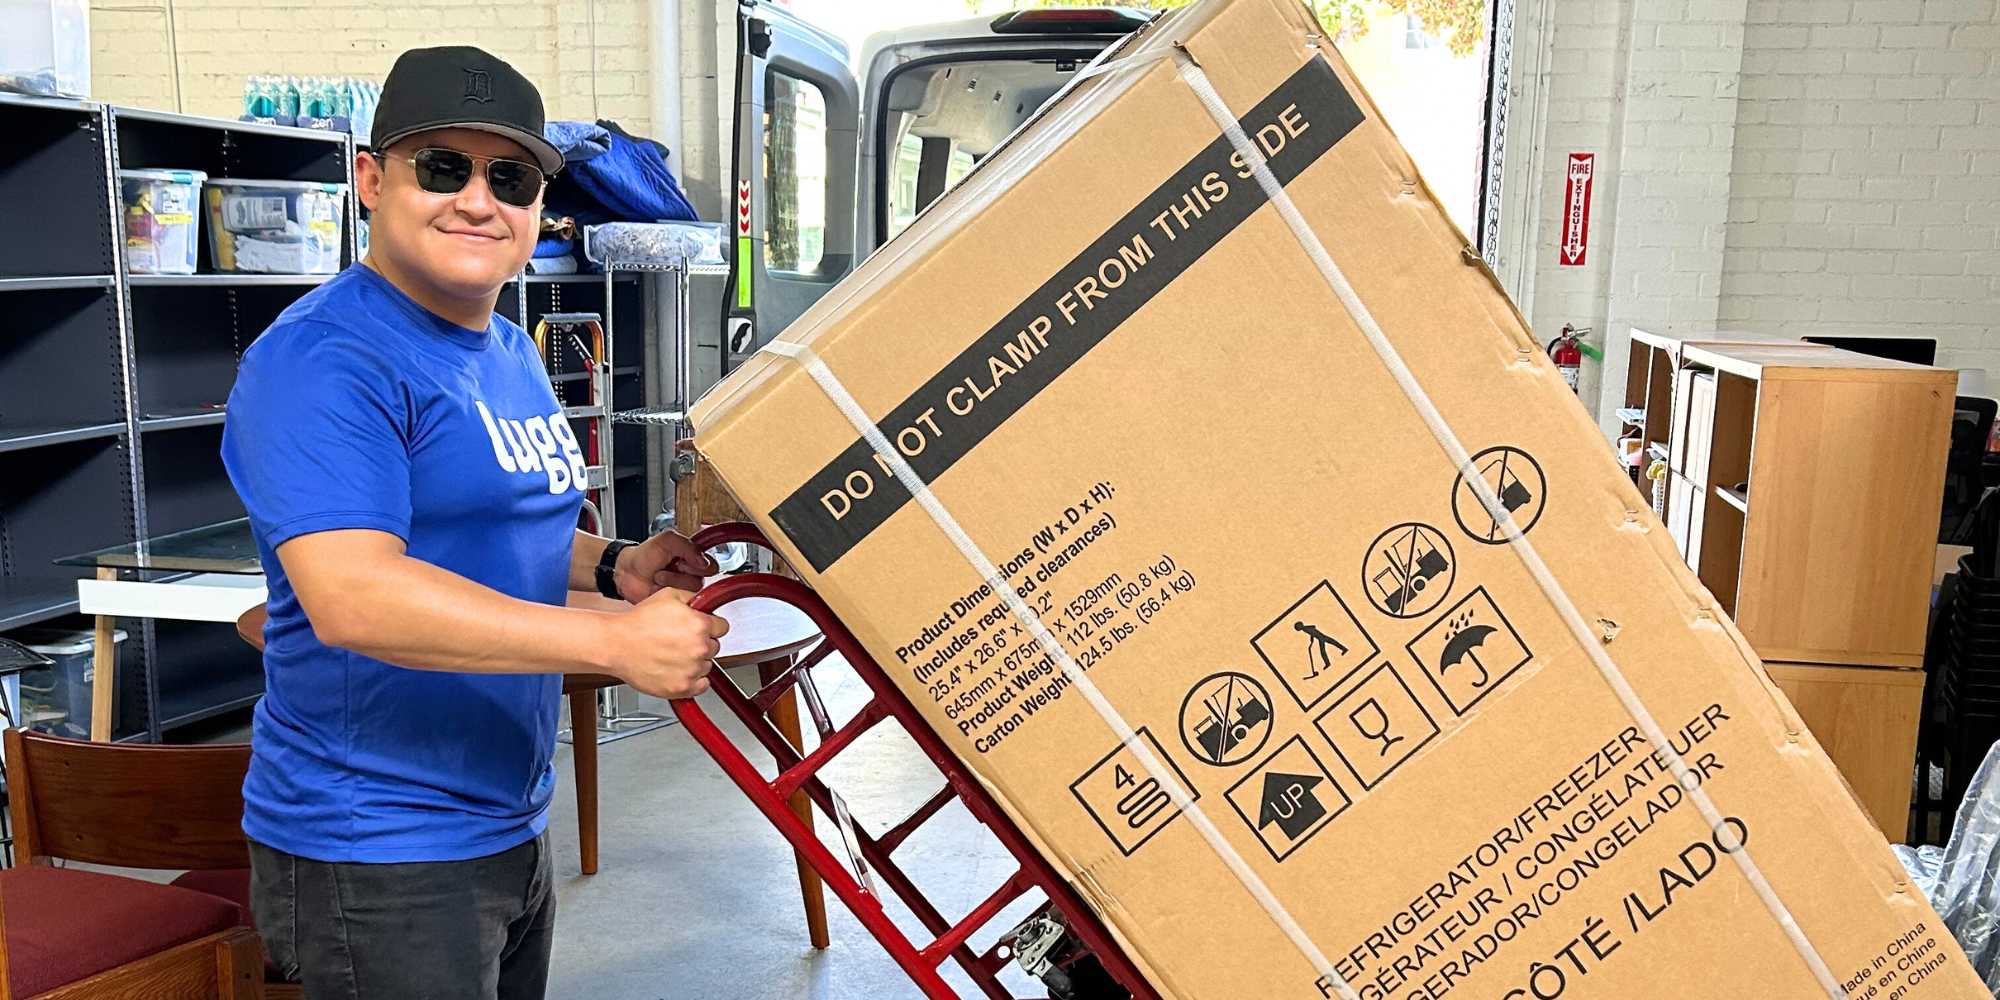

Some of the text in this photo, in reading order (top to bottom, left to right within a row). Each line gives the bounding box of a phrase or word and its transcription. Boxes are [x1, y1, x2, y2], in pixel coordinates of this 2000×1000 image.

[1570, 178, 1582, 257] EXTINGUISHER
[1571, 164, 1589, 174] FIRE
[820, 470, 874, 520] DO
[946, 316, 1052, 417] CLAMP
[1056, 234, 1155, 325] FROM
[1150, 171, 1231, 241] THIS
[475, 401, 588, 495] lugg
[895, 612, 956, 664] Product
[1032, 526, 1056, 554] (W
[1055, 519, 1069, 535] x
[1063, 507, 1080, 525] D
[1079, 499, 1093, 513] x
[1088, 480, 1116, 505] H):
[912, 511, 1117, 684] (Includes requed clearances)
[928, 667, 961, 702] 25.4"
[967, 660, 979, 674] x
[974, 628, 1007, 665] 26.6"
[1009, 622, 1023, 637] x
[944, 676, 997, 720] 645mm
[995, 668, 1008, 682] x
[1053, 618, 1067, 632] x
[1064, 572, 1122, 621] 1529mm
[957, 688, 1017, 737] Product
[1067, 621, 1094, 647] 112
[1089, 606, 1118, 629] lbs.
[1115, 572, 1152, 609] (50.8
[1149, 554, 1177, 580] kg)
[974, 711, 1025, 754] Carton
[1075, 636, 1113, 671] 124.5
[1112, 619, 1139, 643] lbs.
[1135, 587, 1172, 624] (56.4
[1169, 569, 1197, 595] kg)
[1115, 763, 1135, 789] 4
[1270, 783, 1304, 819] UP
[1501, 871, 1513, 896] /
[1515, 703, 1731, 879] CONGÉLATEUER
[1314, 726, 1647, 1000] REFRIGERATOR/FREEZER
[1623, 817, 1748, 932] /LADO
[1870, 955, 1887, 969] in
[1887, 922, 1926, 956] China
[1879, 970, 1897, 987] en
[1897, 937, 1936, 971] Chine
[1889, 952, 1947, 1000] en China
